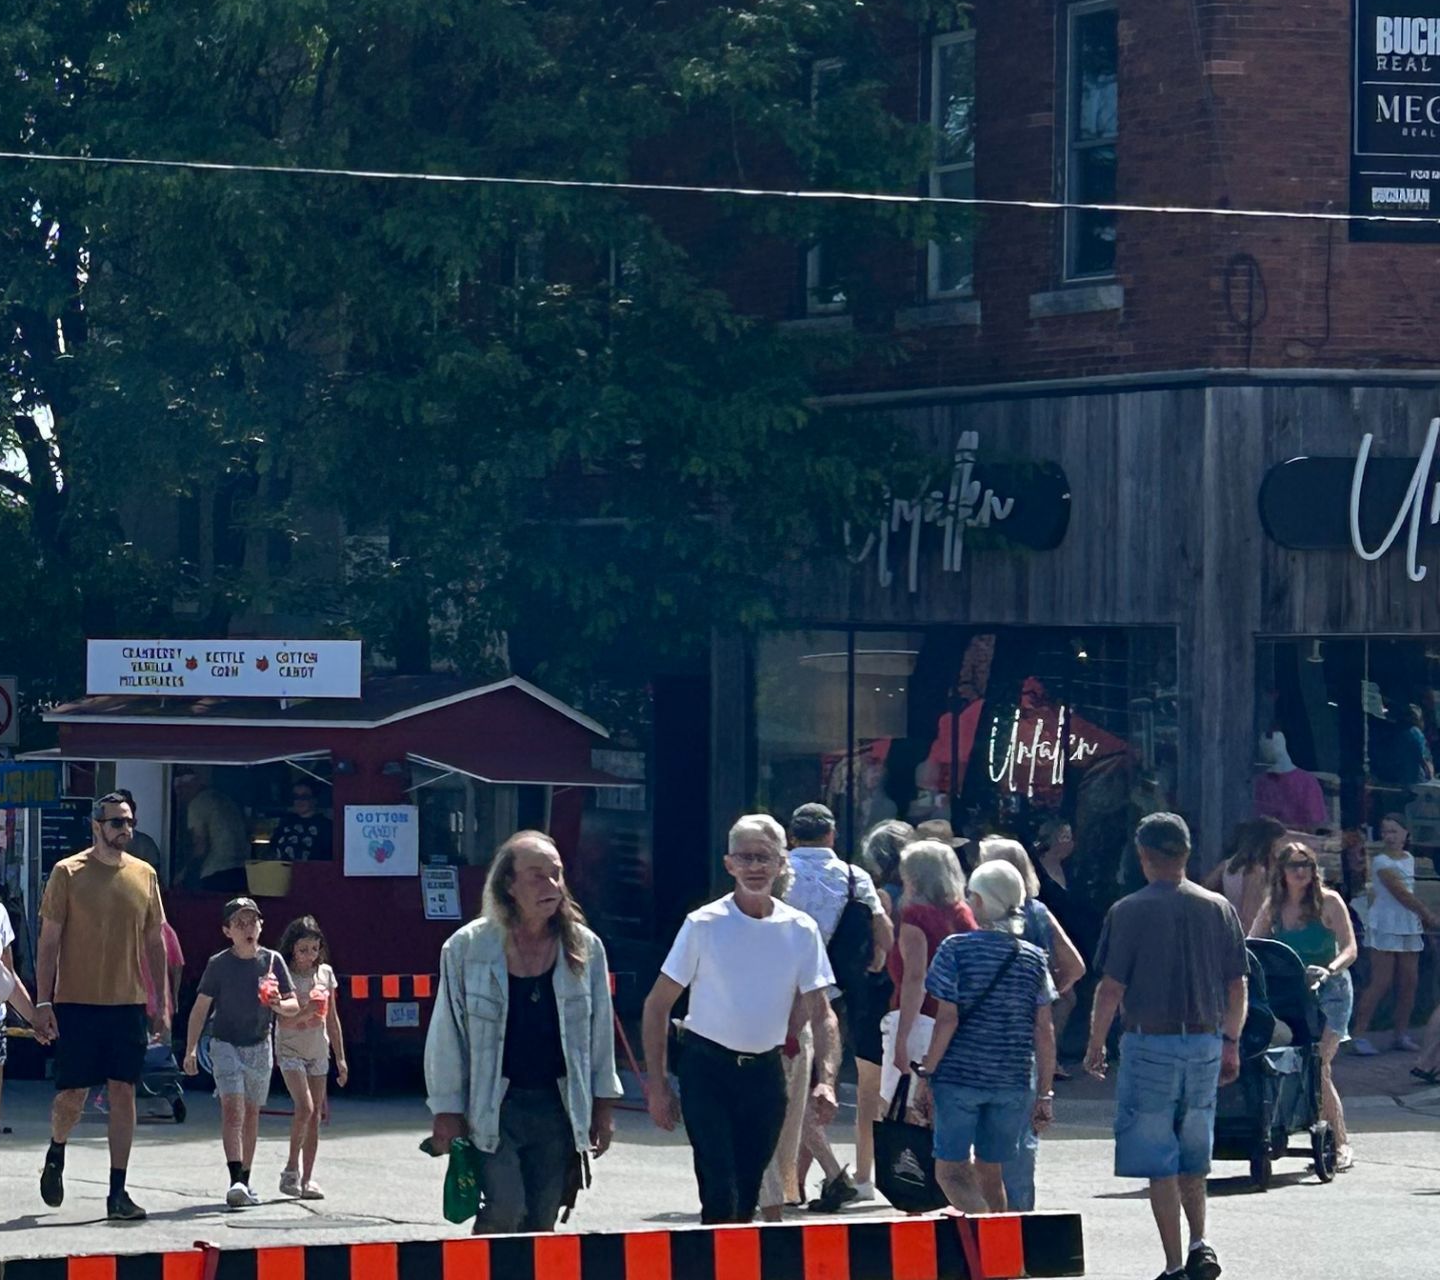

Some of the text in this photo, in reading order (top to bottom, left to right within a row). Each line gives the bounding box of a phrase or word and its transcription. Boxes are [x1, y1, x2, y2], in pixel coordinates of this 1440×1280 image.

[1376, 56, 1432, 71] REAL
[206, 651, 245, 664] KETTLE
[276, 651, 318, 664] COTTON
[211, 665, 239, 677] CORN
[279, 666, 315, 678] CANDY
[356, 812, 409, 823] COTTON
[362, 824, 399, 839] CANDY
